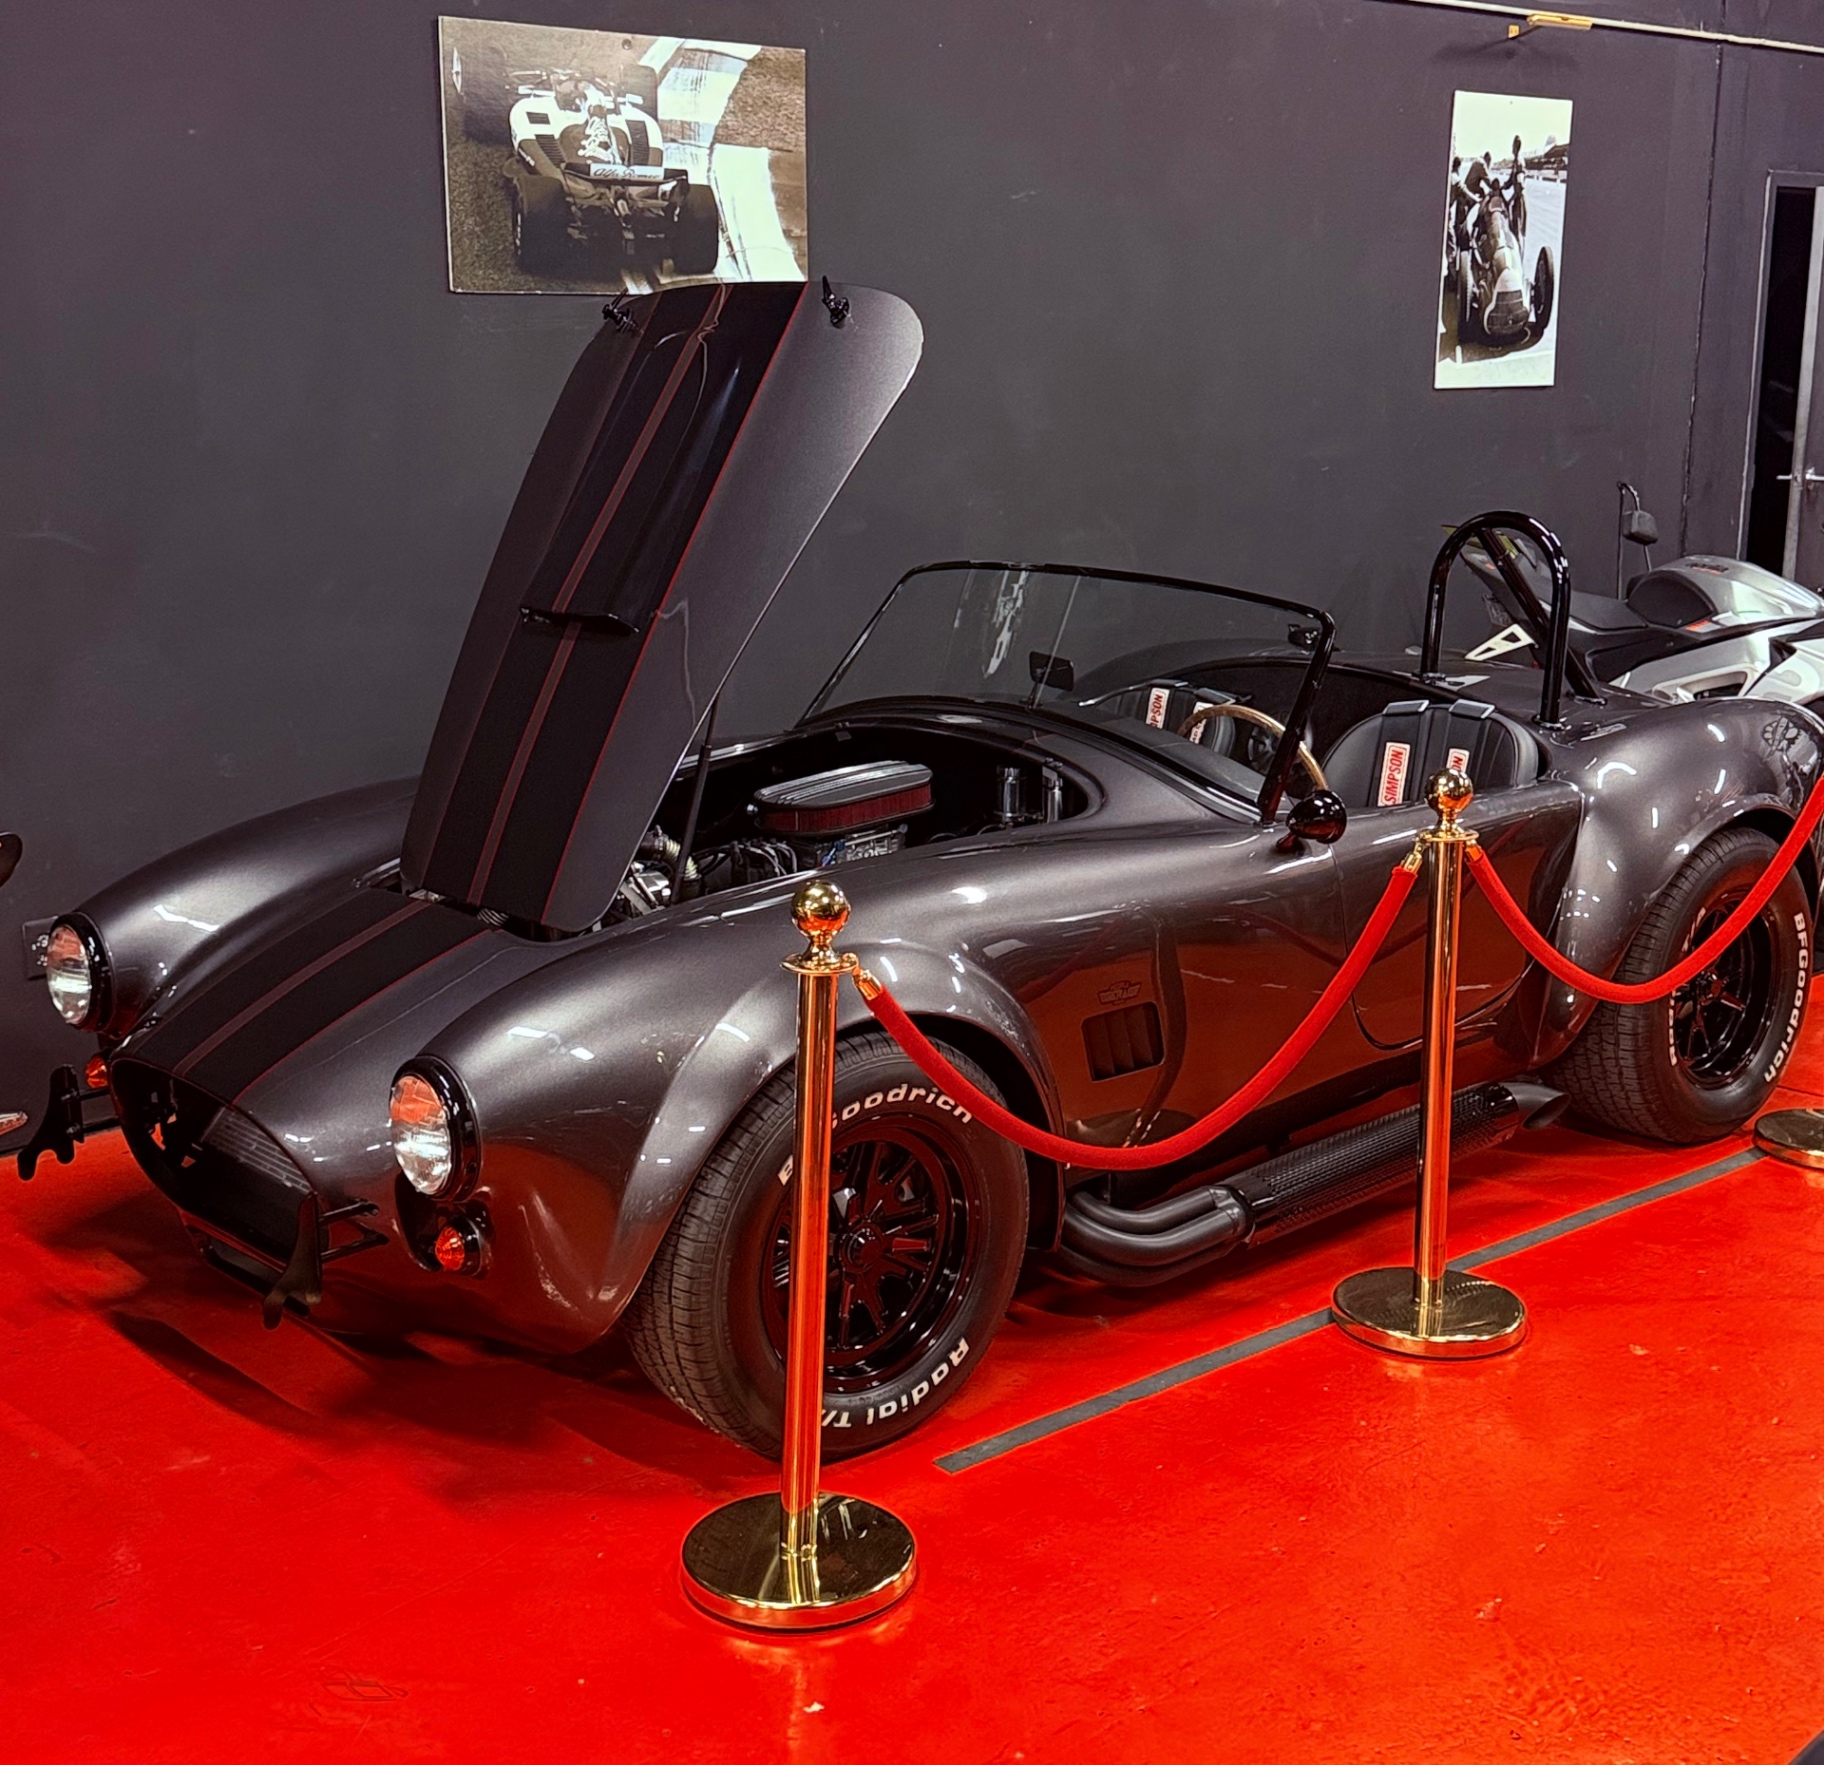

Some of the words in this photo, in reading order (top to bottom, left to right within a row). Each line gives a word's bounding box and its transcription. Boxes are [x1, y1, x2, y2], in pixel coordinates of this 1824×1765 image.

[622, 168, 661, 180] Romeo
[1382, 748, 1404, 805] SIMPSON
[1763, 912, 1809, 1083] BFGoodrich
[866, 1337, 970, 1425] Radial
[820, 1409, 852, 1428] T/
